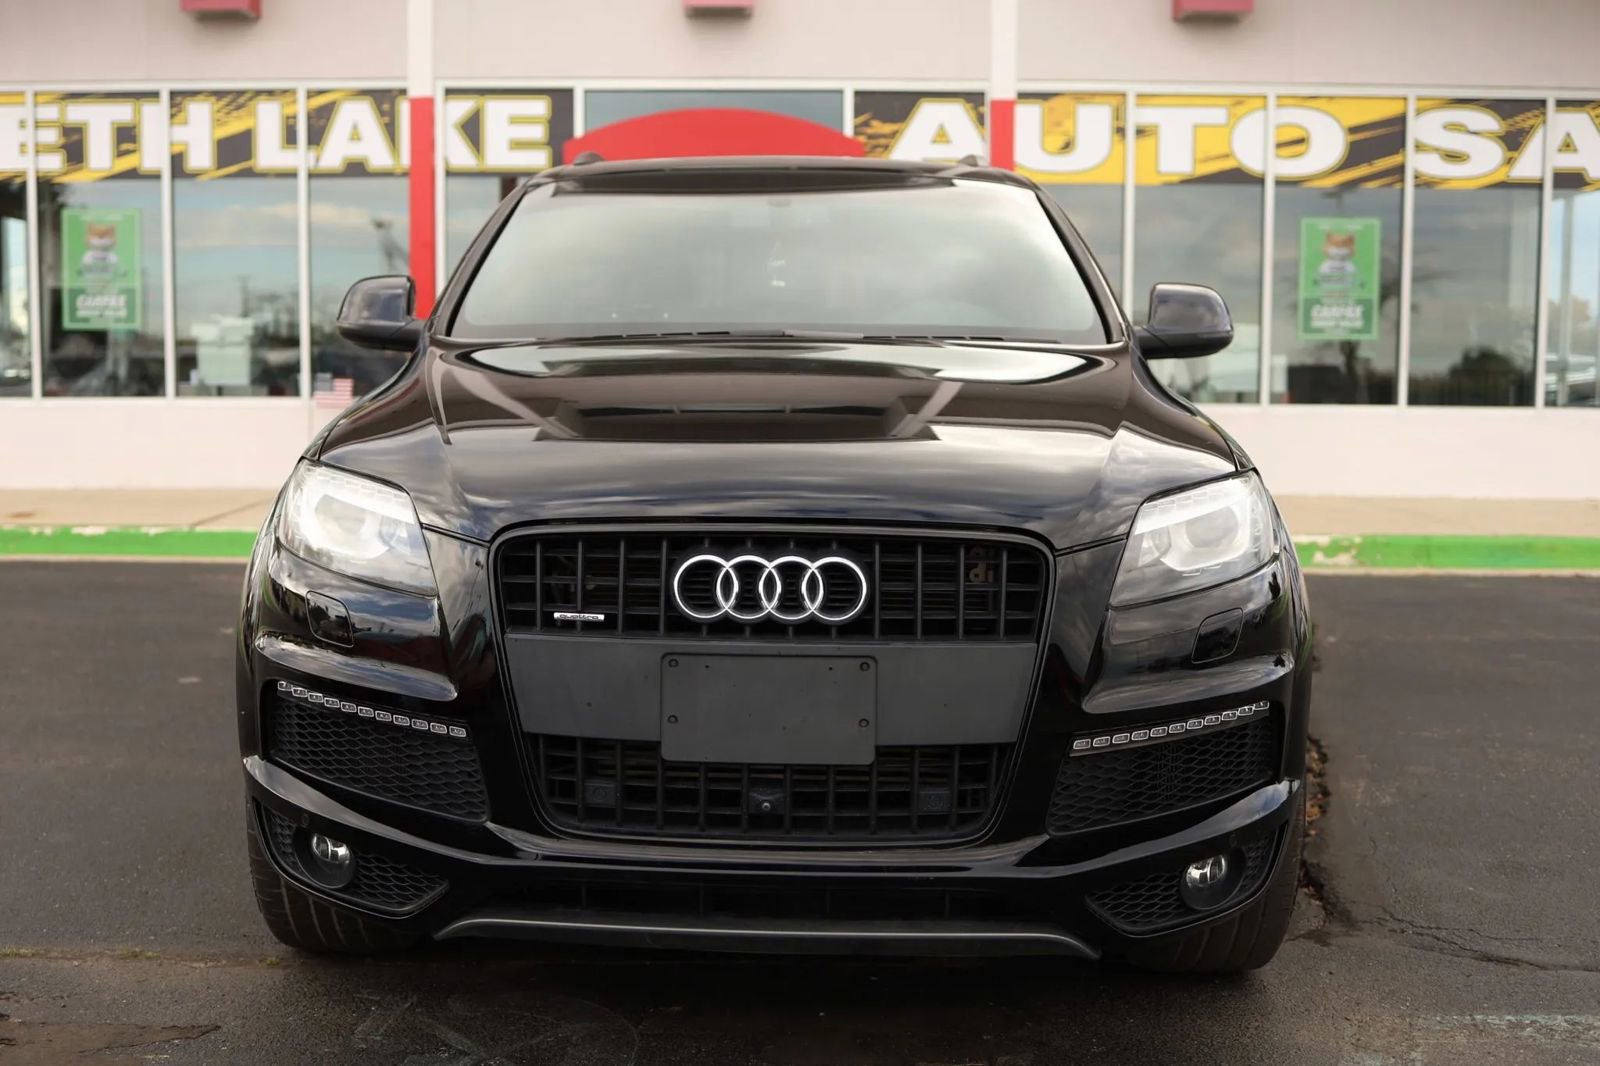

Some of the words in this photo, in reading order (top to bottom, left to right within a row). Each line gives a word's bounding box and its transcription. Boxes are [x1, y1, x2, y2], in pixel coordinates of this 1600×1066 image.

[253, 96, 552, 172] LAKE
[886, 98, 1349, 181] AUTO
[1406, 104, 1600, 183] SA
[558, 613, 600, 621] quattro
